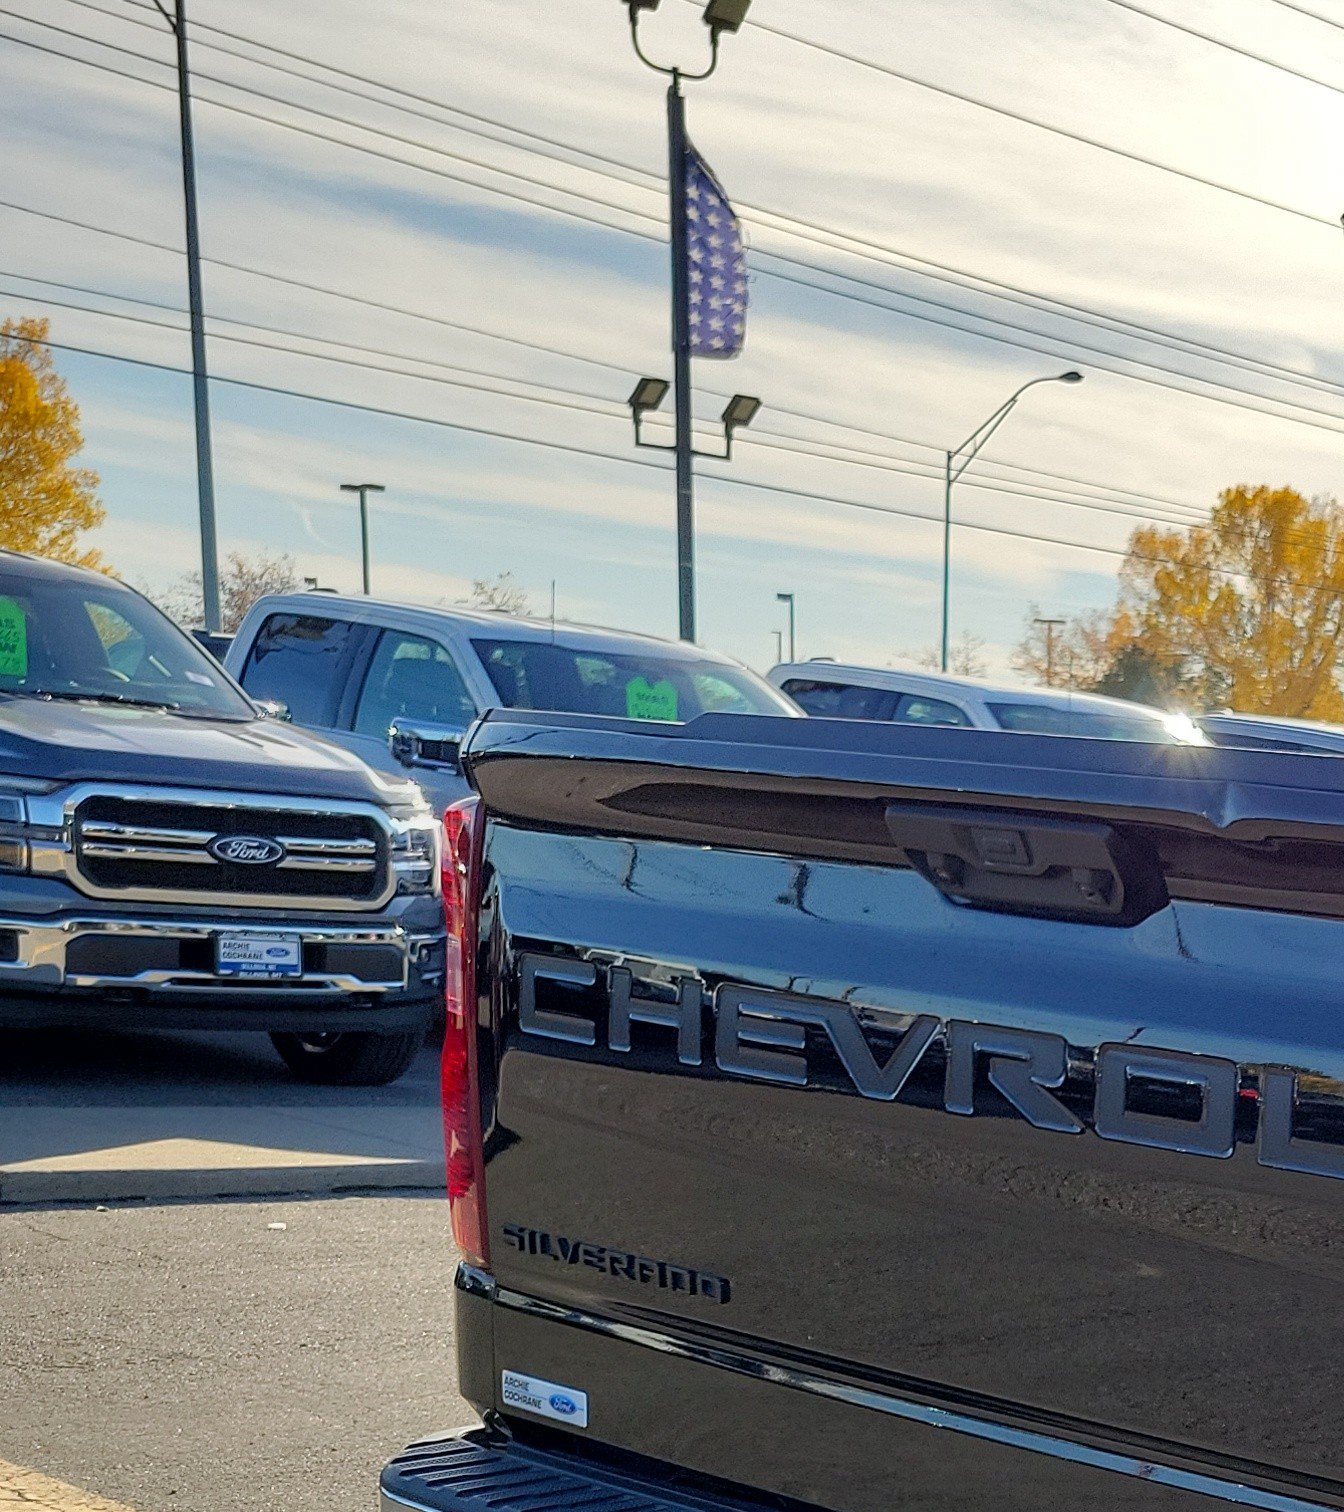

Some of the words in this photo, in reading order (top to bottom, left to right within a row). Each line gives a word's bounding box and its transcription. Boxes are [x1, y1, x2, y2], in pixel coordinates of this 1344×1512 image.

[227, 840, 271, 860] Ford
[501, 1223, 732, 1304] SILVERADO
[504, 1376, 529, 1392] ARCHIE
[504, 1389, 542, 1409] COCHRANE
